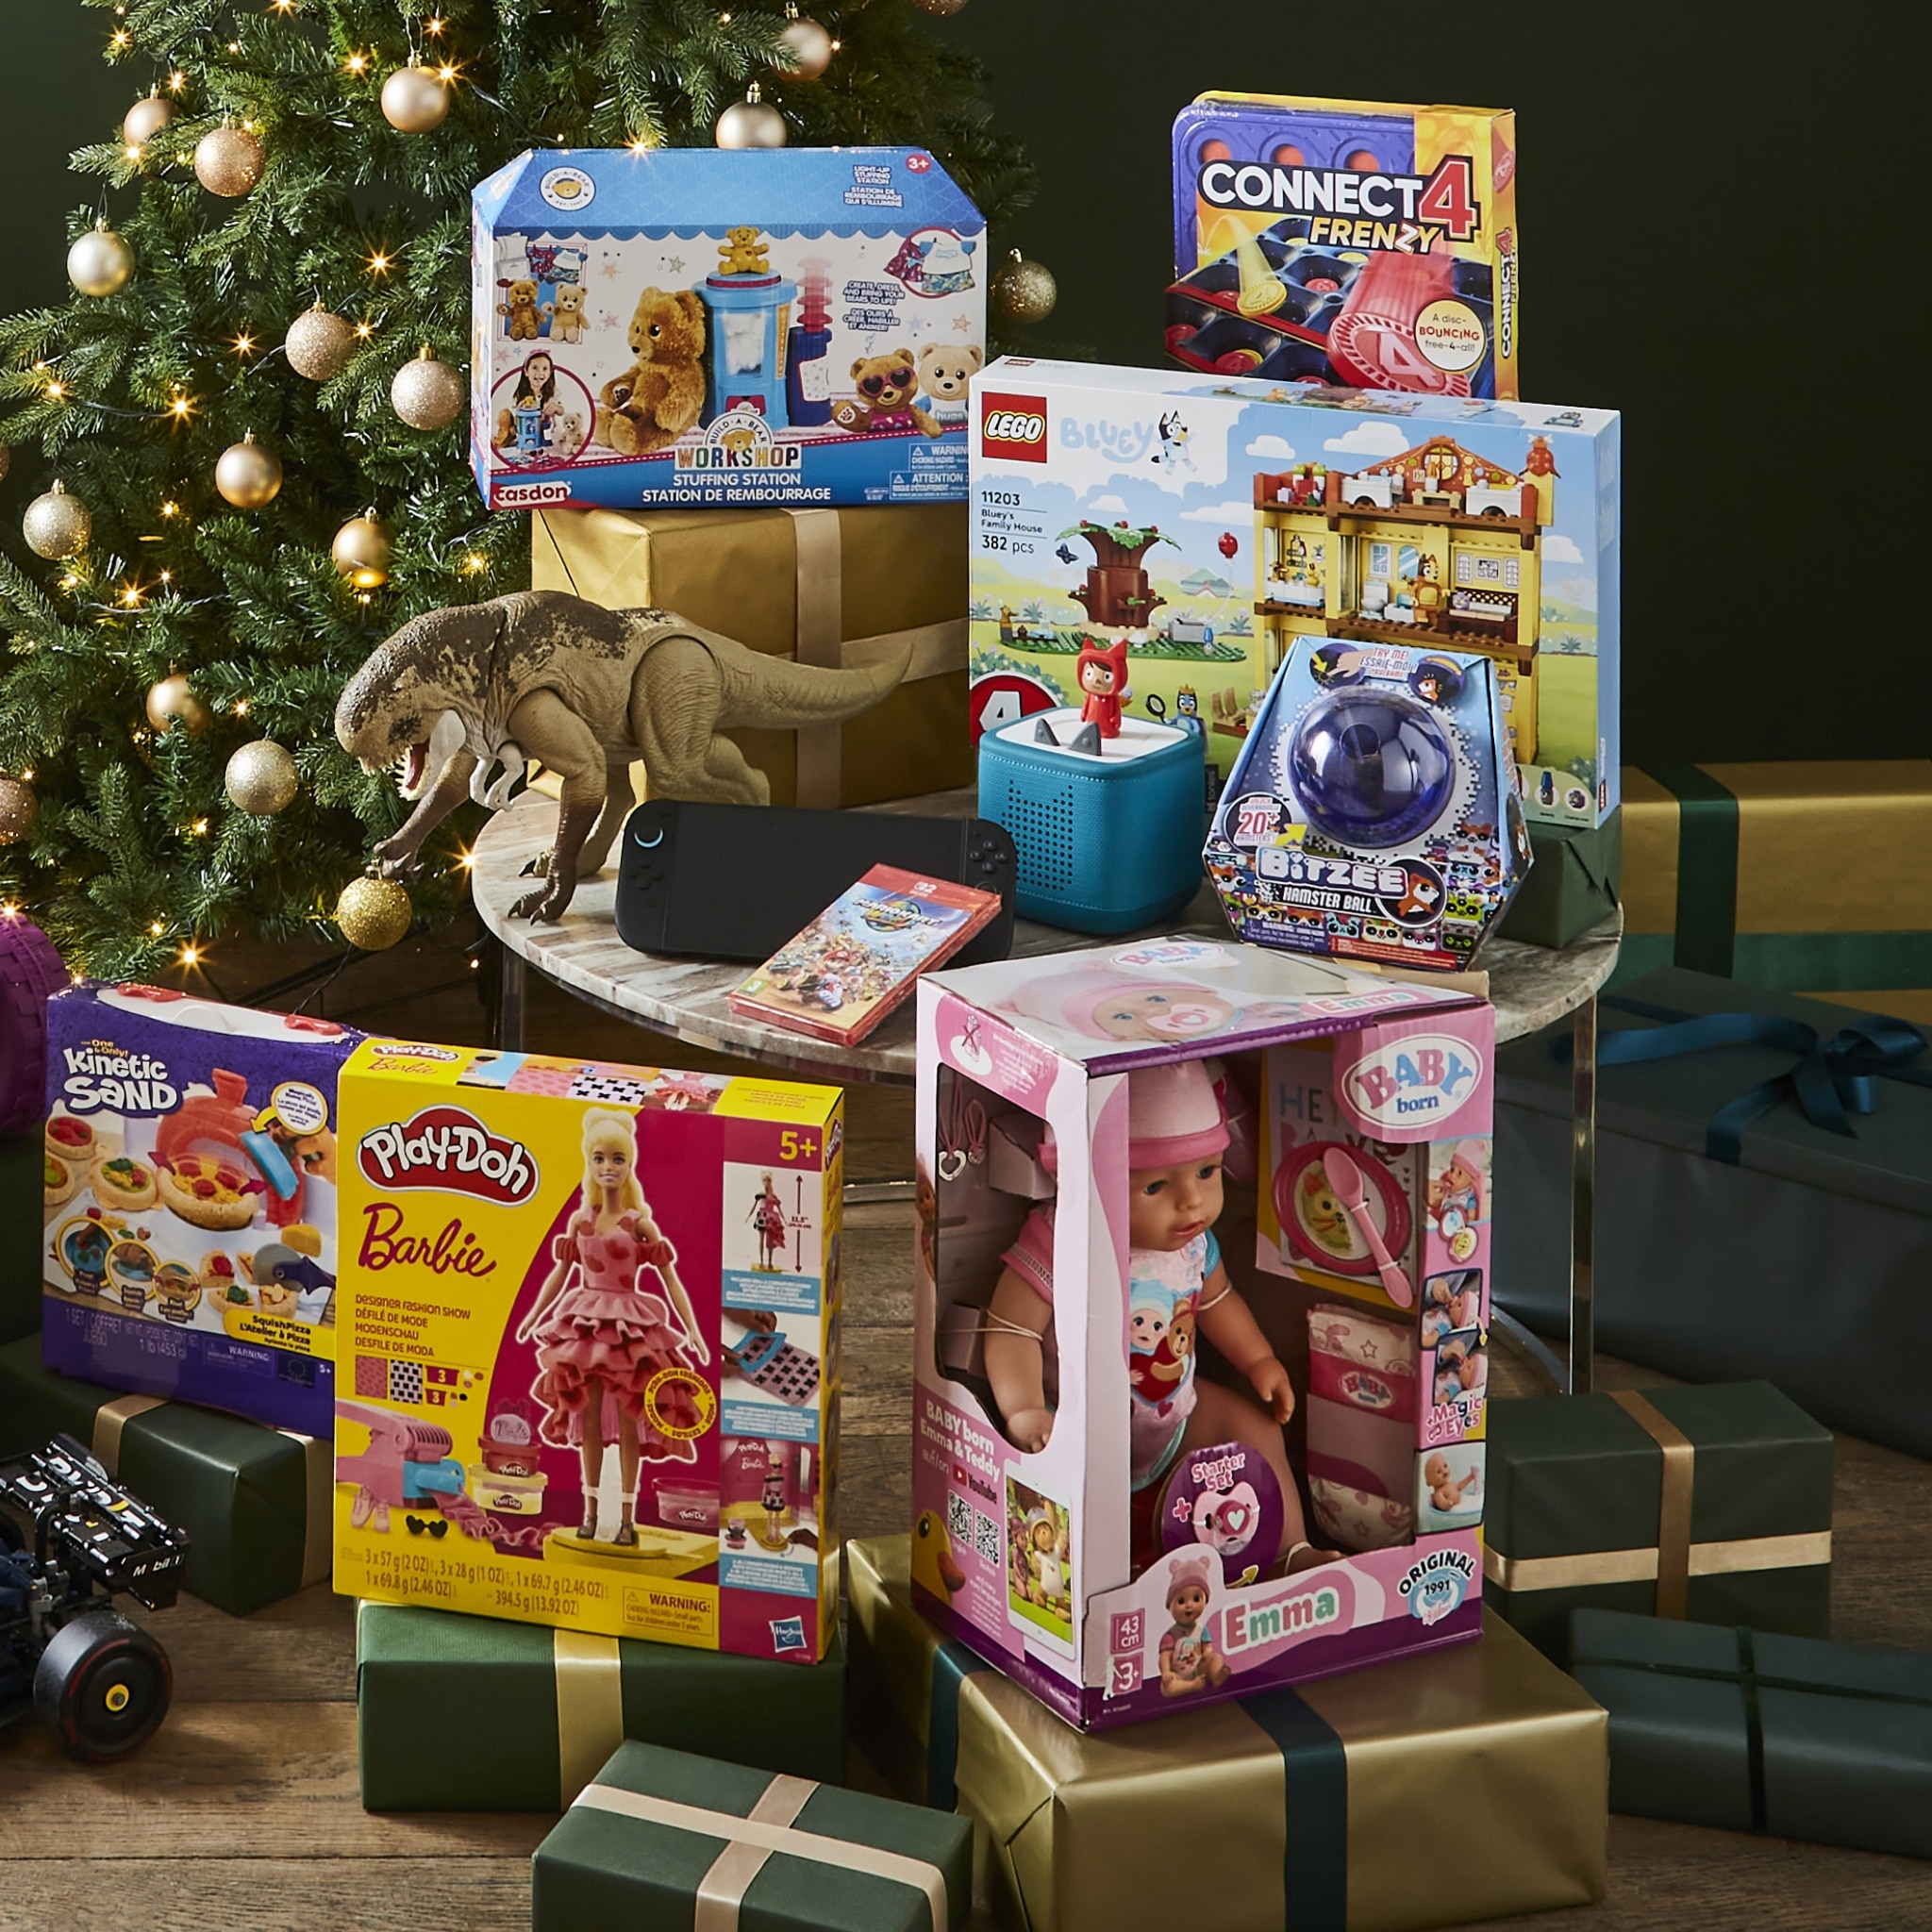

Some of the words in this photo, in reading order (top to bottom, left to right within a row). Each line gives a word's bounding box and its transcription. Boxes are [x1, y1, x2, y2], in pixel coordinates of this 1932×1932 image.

[908, 158, 929, 170] 3+
[851, 187, 884, 195] STATION
[1201, 162, 1424, 219] CONNECT
[1419, 158, 1477, 239] 4
[1309, 217, 1441, 255] FRENZY
[1495, 227, 1512, 255] 4
[1501, 254, 1511, 358] CONNECT
[1432, 313, 1440, 322] A
[1419, 325, 1480, 341] BOUNCING
[986, 412, 1044, 441] LEGO
[931, 446, 968, 456] WARNIN
[1059, 417, 1155, 464] BLUEY
[677, 446, 801, 469] WORKSHOP
[674, 475, 739, 487] STUFFING
[741, 474, 801, 486] STATION
[912, 474, 963, 483] ATTENTION
[496, 485, 567, 502] casdon
[642, 490, 703, 502] STATION
[706, 490, 724, 502] DE
[726, 488, 831, 501] REMBOURRAGE
[981, 491, 1021, 507] 11203
[981, 509, 1014, 521] Bluey's
[981, 520, 1012, 531] Family
[1014, 522, 1043, 534] House
[982, 535, 1008, 551] 382
[1012, 541, 1035, 555] pcs
[1373, 647, 1390, 658] TRY
[1391, 649, 1409, 659] ME!
[1238, 811, 1278, 835] 20+
[1282, 887, 1341, 908] HAMSTER
[1342, 895, 1373, 913] BALL
[1122, 943, 1212, 967] BABY
[1319, 992, 1417, 1013] Emma
[92, 1039, 114, 1047] One
[368, 1058, 439, 1075] Barbie
[1354, 1048, 1474, 1110] BABY
[1396, 1095, 1441, 1114] born
[779, 1130, 817, 1161] 5+
[358, 1201, 497, 1277] Barbie
[355, 1307, 386, 1323] DÉFILÉ
[387, 1312, 399, 1324] DE
[401, 1314, 428, 1328] MODE
[442, 1306, 471, 1320] SHOW
[240, 1323, 276, 1338] L'Atelier
[278, 1329, 285, 1339] à
[287, 1333, 311, 1345] Pizza
[355, 1323, 419, 1341] MODENSCHAU
[355, 1336, 391, 1351] DESFILE
[392, 1341, 404, 1353] DE
[406, 1344, 435, 1357] MODA
[438, 1370, 446, 1383] 3
[432, 1391, 440, 1404] 3
[925, 1400, 962, 1436] BABY
[962, 1420, 995, 1456] born
[1446, 1412, 1481, 1439] Eyes
[920, 1418, 954, 1452] Emma
[954, 1439, 964, 1459] &
[964, 1443, 1001, 1484] Teddy
[1191, 1453, 1245, 1484] Starter
[968, 1473, 998, 1505] YouTube
[1205, 1470, 1235, 1491] Set
[365, 1548, 371, 1564] 3
[373, 1554, 378, 1563] x
[380, 1550, 392, 1566] 57
[392, 1557, 400, 1572] g
[440, 1560, 446, 1575] 3
[447, 1565, 454, 1575] x
[456, 1562, 468, 1578] 28
[468, 1568, 475, 1583] g
[516, 1571, 521, 1586] 1
[523, 1576, 529, 1587] x
[530, 1573, 551, 1591] 69.7
[553, 1580, 559, 1595] g
[561, 1577, 585, 1596] (2.46
[1398, 1550, 1475, 1595] ORIGINAL
[365, 1571, 371, 1585] 1
[373, 1574, 379, 1586] x
[380, 1572, 401, 1590] 69.8
[402, 1580, 408, 1595] g
[409, 1575, 434, 1595] (2.46
[1424, 1579, 1451, 1596] 1991
[495, 1590, 522, 1608] 394.5
[523, 1598, 530, 1613] g
[531, 1594, 561, 1614] (13.92
[649, 1592, 710, 1613] WARNING:
[1120, 1615, 1141, 1637] 43
[1225, 1589, 1337, 1650] Emma
[1120, 1631, 1141, 1647] cm
